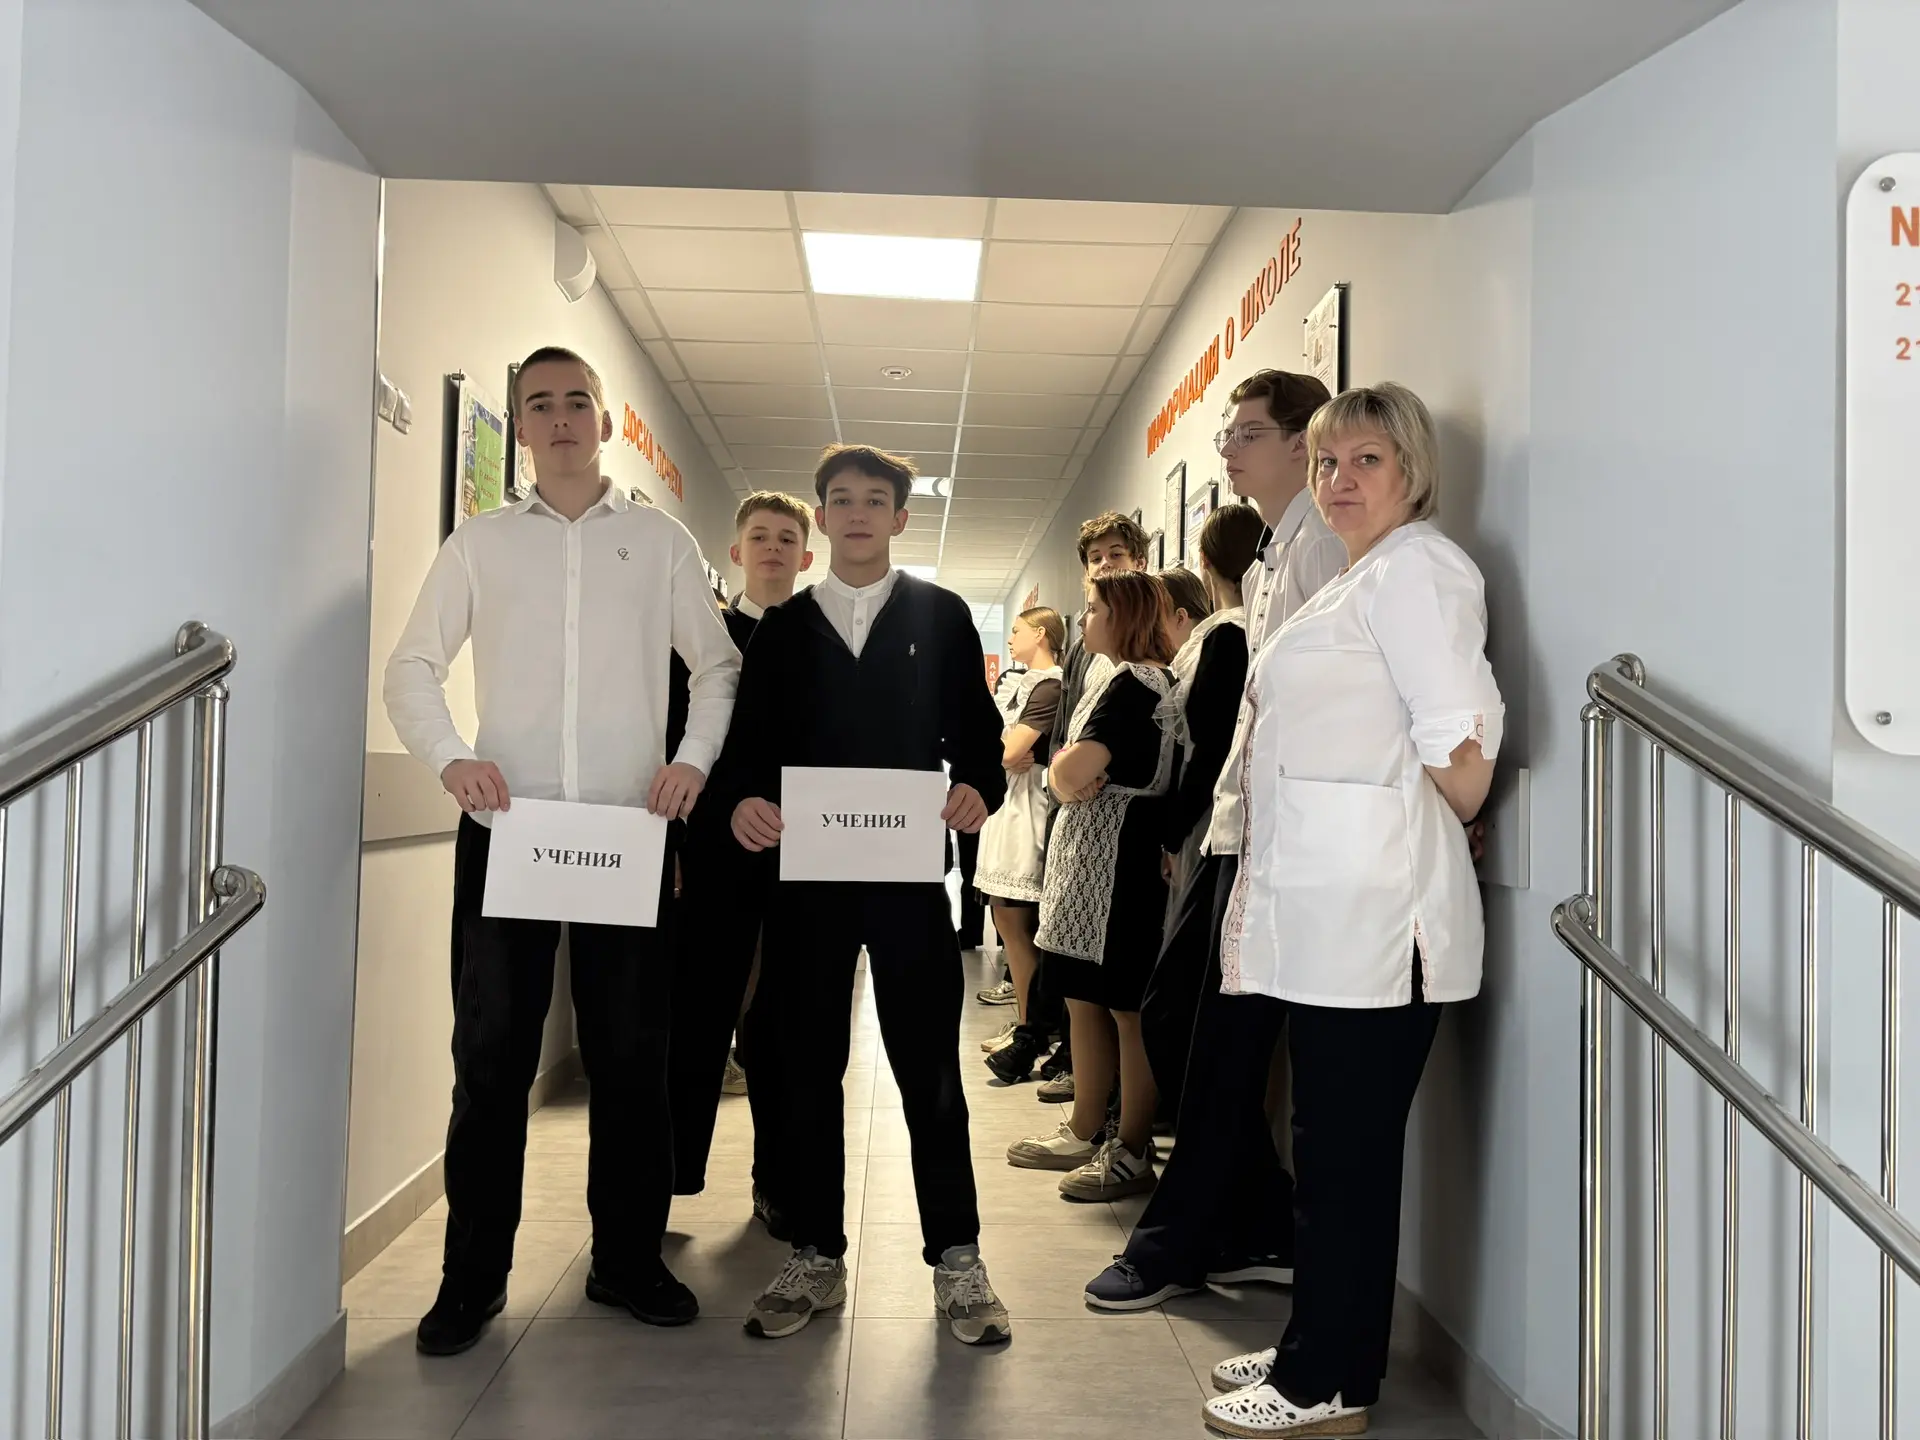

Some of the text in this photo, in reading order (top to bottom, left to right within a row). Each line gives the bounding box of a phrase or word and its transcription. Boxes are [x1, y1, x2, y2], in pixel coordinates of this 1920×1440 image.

[1146, 217, 1302, 459] ИНФОРМАЦИЯ О ШКОЛЕ
[622, 402, 653, 466] ДОСКА
[821, 813, 907, 829] УЧЕНИЯ
[532, 847, 624, 869] УЧЕНИЯ
